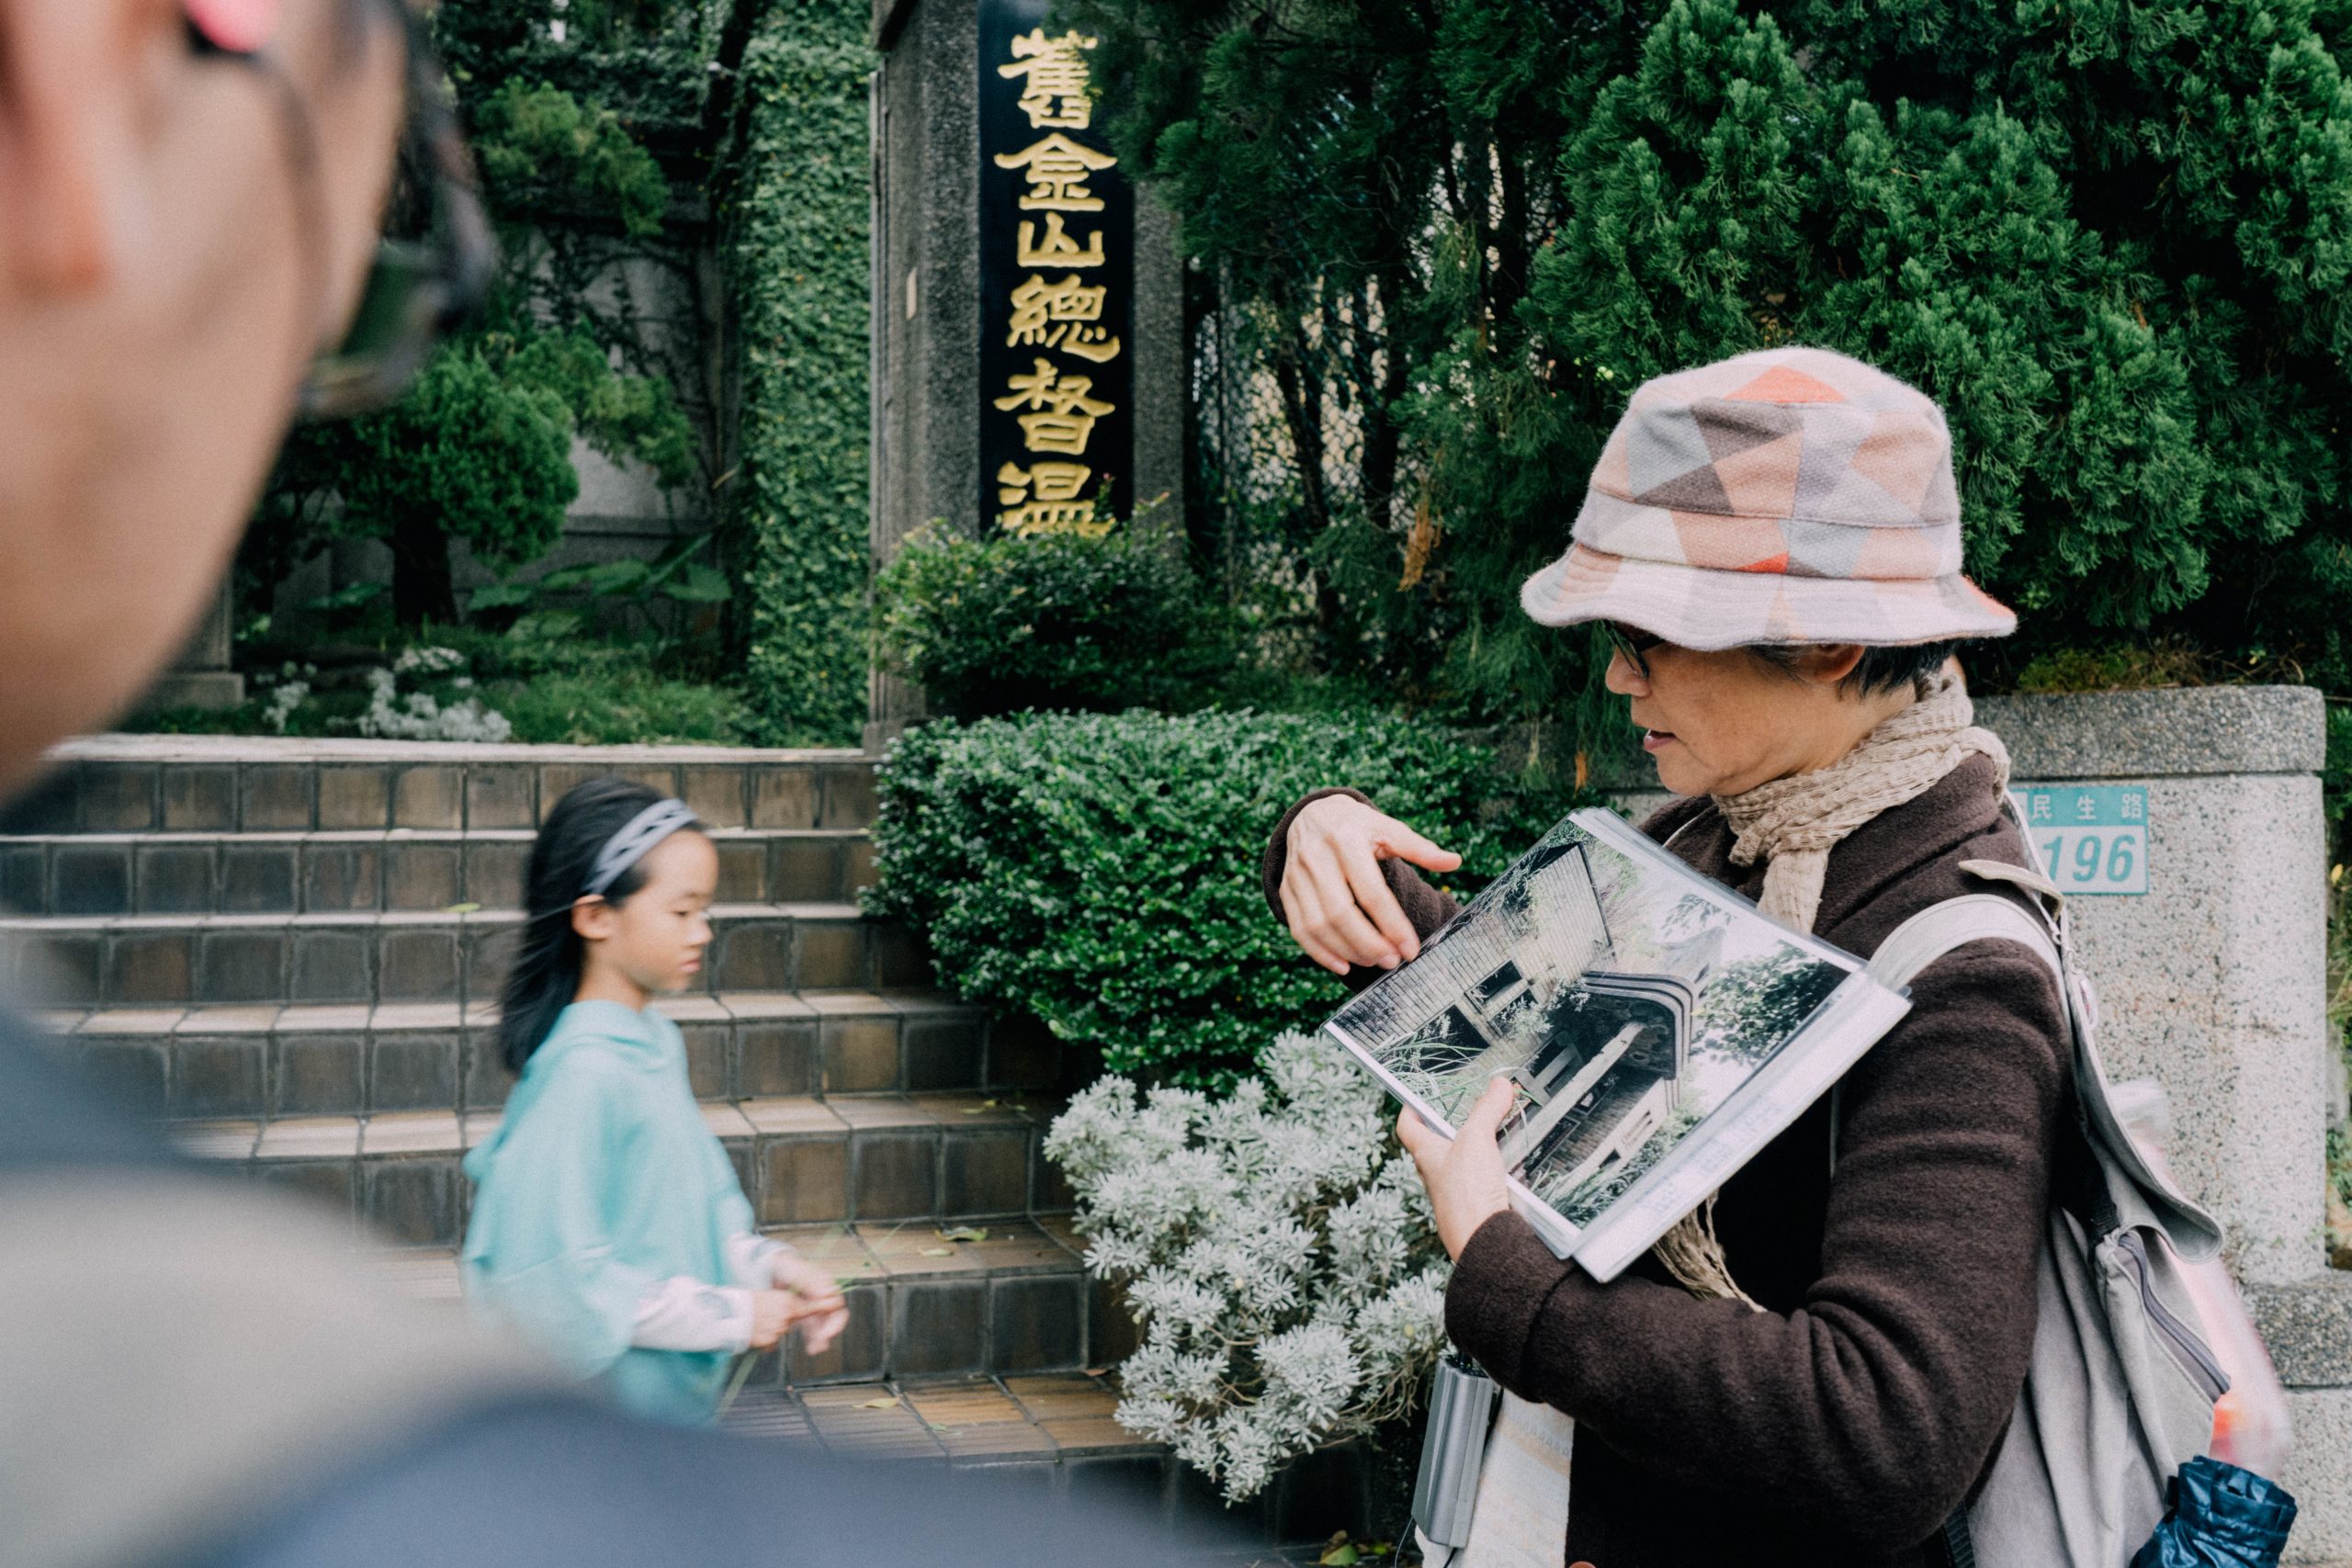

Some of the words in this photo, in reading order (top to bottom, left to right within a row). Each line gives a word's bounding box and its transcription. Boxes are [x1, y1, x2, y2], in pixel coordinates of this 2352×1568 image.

[2032, 794, 2143, 820] 民生路
[2042, 834, 2136, 882] 196
